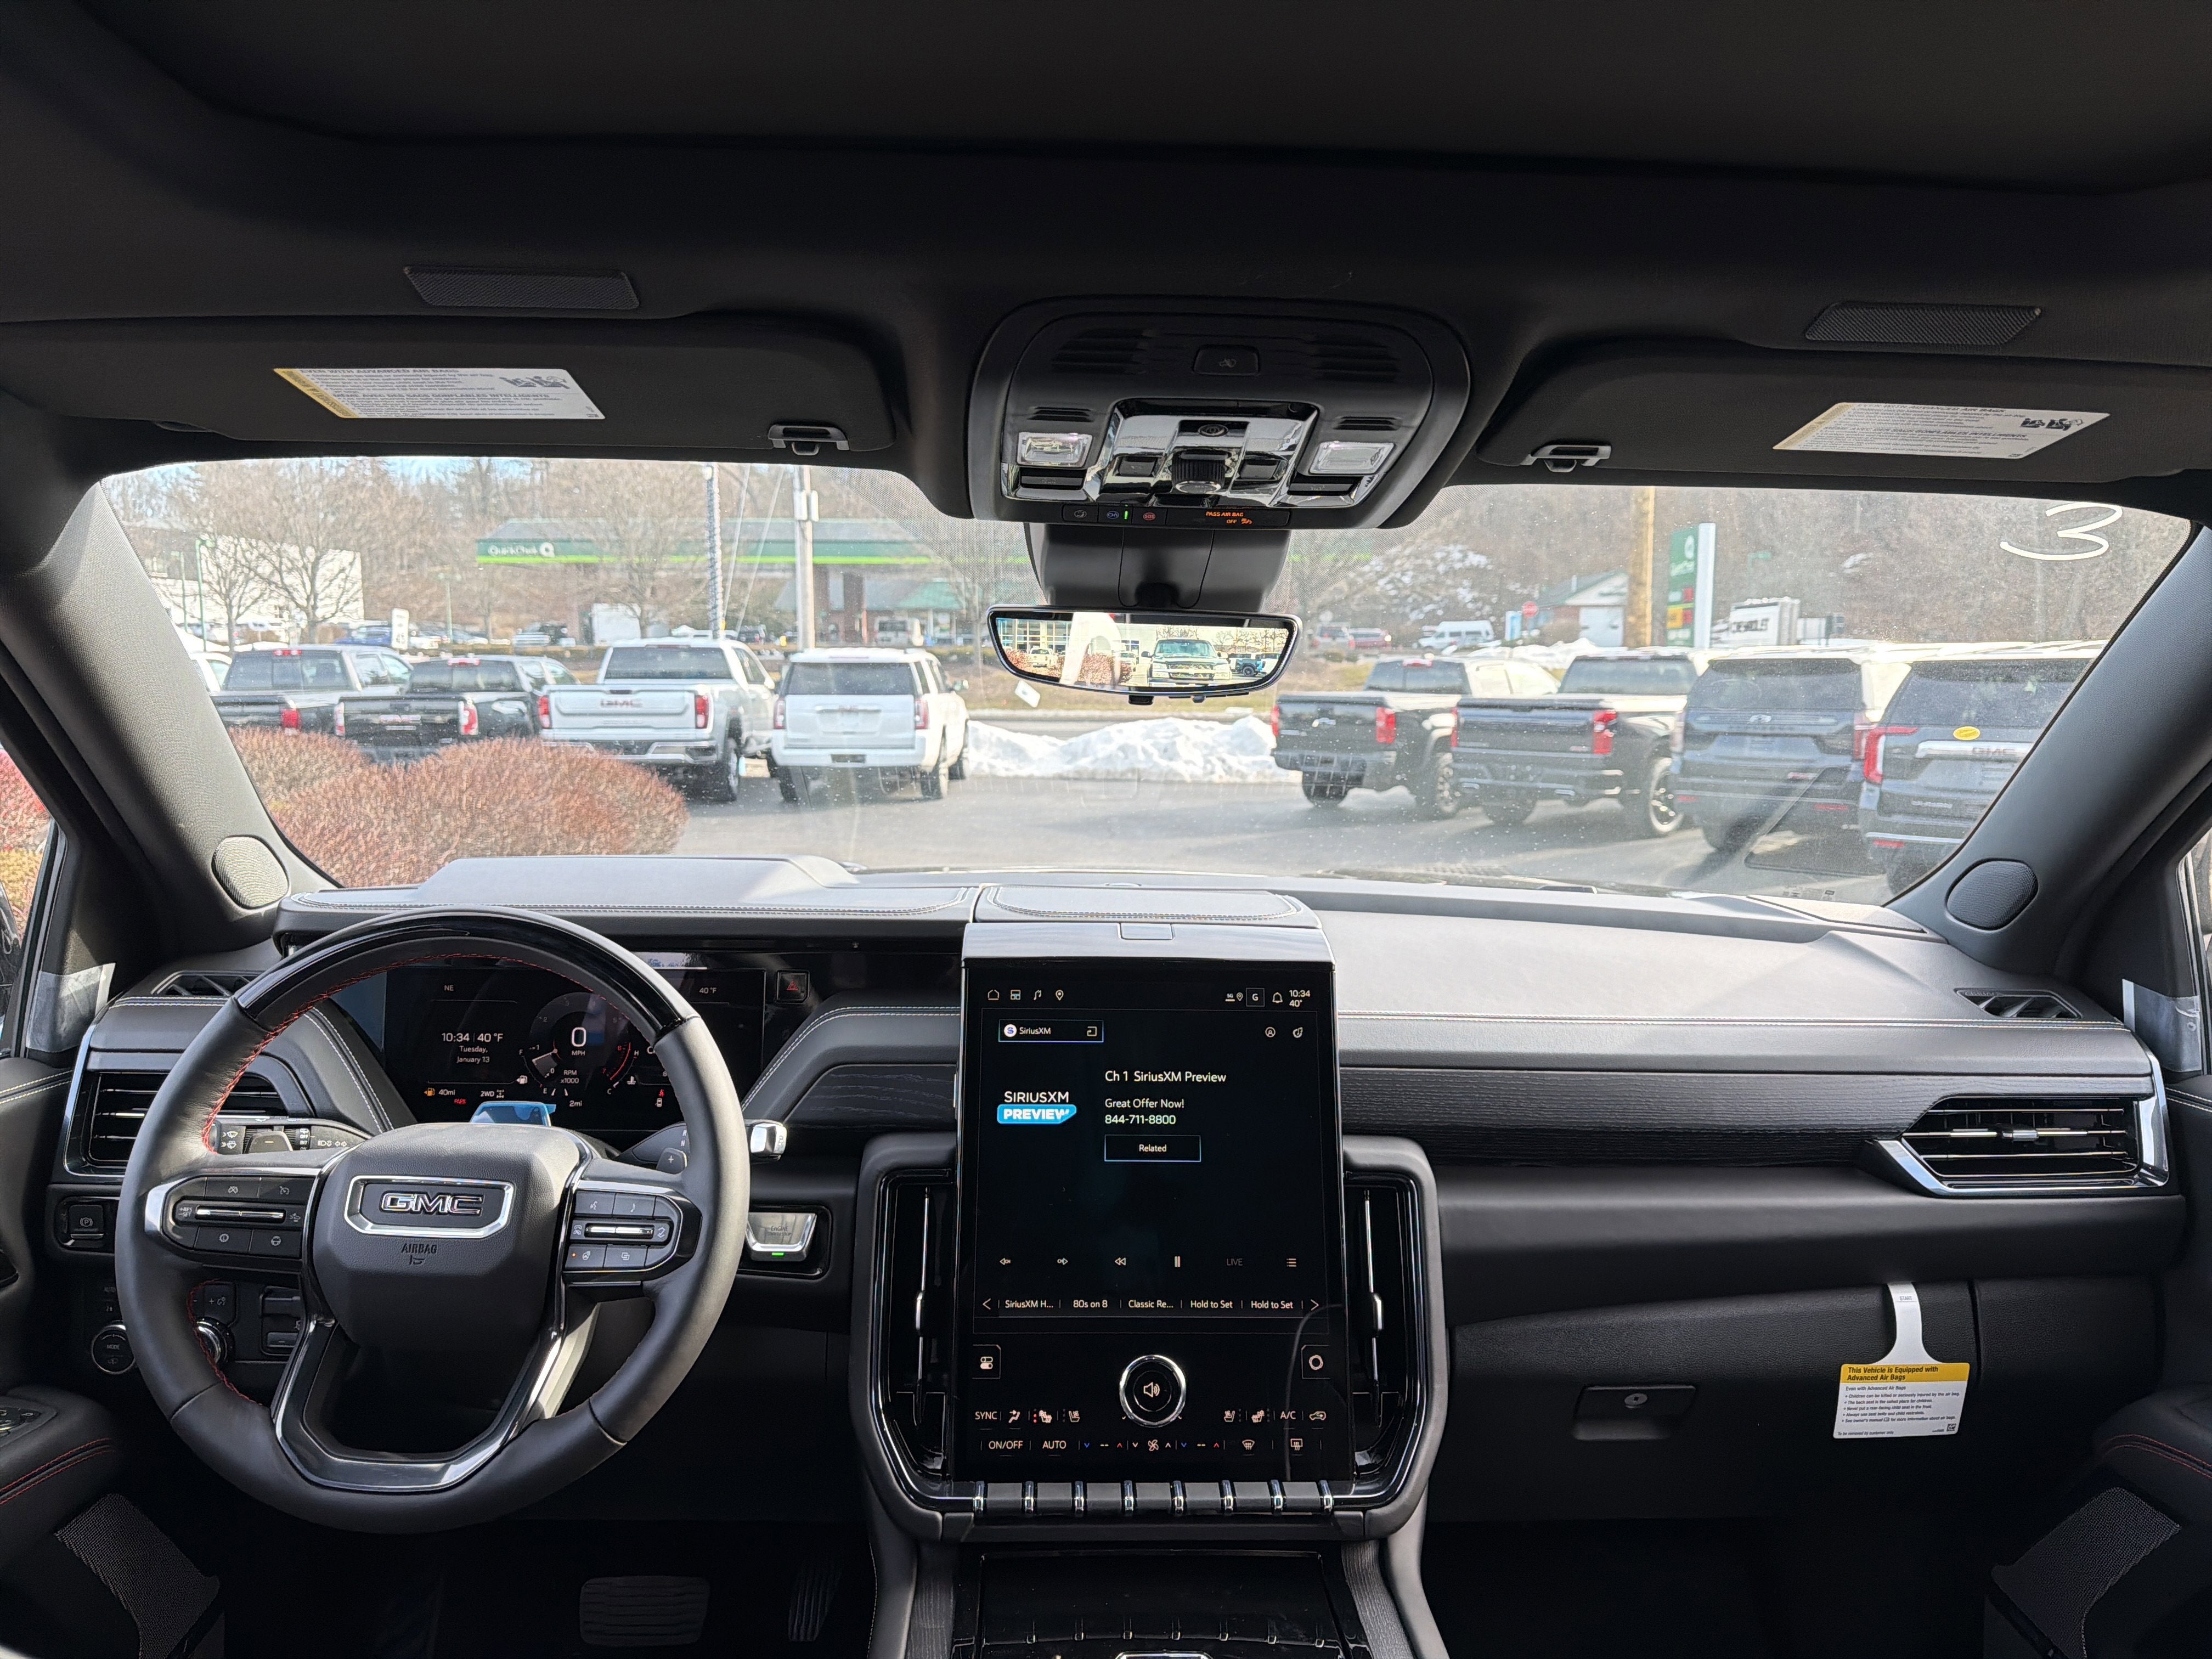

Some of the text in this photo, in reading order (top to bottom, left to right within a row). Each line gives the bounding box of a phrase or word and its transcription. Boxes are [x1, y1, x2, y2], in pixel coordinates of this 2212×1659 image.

[1252, 993, 1259, 1001] G
[1289, 999, 1302, 1007] 40°
[1019, 1026, 1051, 1035] SiriusXM
[441, 1032, 504, 1042] 10:34 40 °F
[571, 1027, 586, 1047] 0
[459, 1045, 488, 1054] Tuesday,
[1105, 1070, 1227, 1083] Ch 1 SiriusXM Preview
[1004, 1091, 1069, 1103] SIRIUSXM
[1105, 1098, 1184, 1108] Great Offer Now!
[1003, 1109, 1070, 1120] PREVIEW
[1105, 1115, 1176, 1125] 844-711-8800
[1139, 1144, 1167, 1153] Related
[380, 1192, 484, 1215] GMC
[401, 1243, 437, 1254] AIRBAG
[1226, 1258, 1243, 1266] LIVE
[1005, 1300, 1038, 1308] SiriusXM
[1073, 1300, 1090, 1308] 80s
[1102, 1300, 1108, 1308] 8
[1128, 1300, 1154, 1309] Classic
[1190, 1300, 1233, 1309] Hold to Set
[1251, 1300, 1293, 1310] Hold to Set
[1894, 1366, 1923, 1375] Equipped
[1890, 1374, 1906, 1382] Bags
[975, 1410, 997, 1420] SYNC
[1280, 1410, 1296, 1420] A/C
[989, 1440, 1023, 1450] ON/OFF
[1042, 1440, 1066, 1450] AUTO
